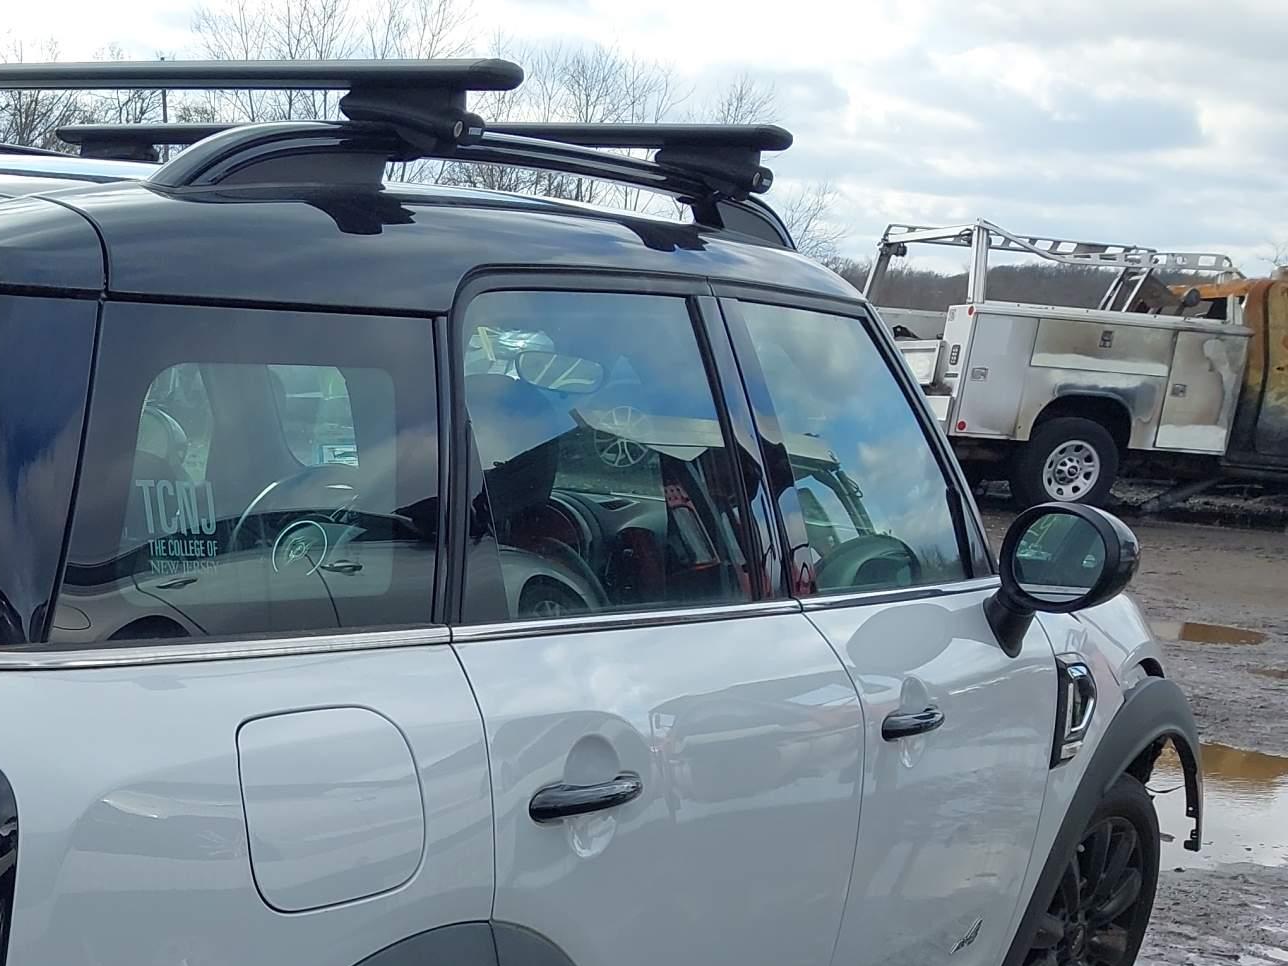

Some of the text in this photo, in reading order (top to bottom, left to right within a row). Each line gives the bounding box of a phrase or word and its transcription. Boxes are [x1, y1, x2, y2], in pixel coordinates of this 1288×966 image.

[135, 479, 217, 536] TCNJ
[148, 540, 219, 557] THE COLLEGE OF
[148, 560, 221, 576] NEW JERSEY
